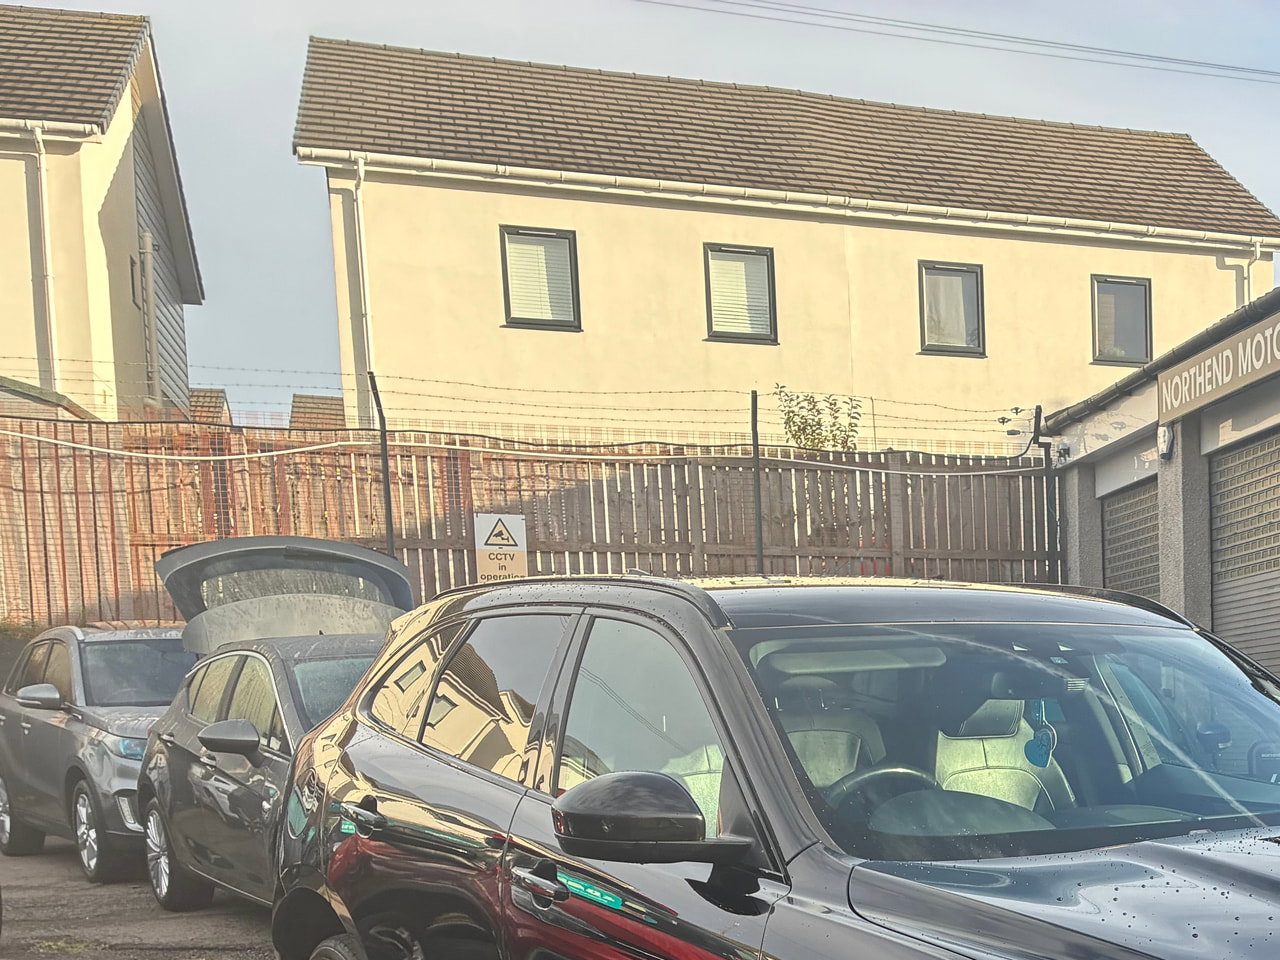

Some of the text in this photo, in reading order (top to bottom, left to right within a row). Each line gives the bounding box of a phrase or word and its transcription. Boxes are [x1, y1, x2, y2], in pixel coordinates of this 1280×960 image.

[1161, 349, 1234, 413] NORTHEND
[488, 553, 515, 561] CCTV
[498, 562, 507, 571] in
